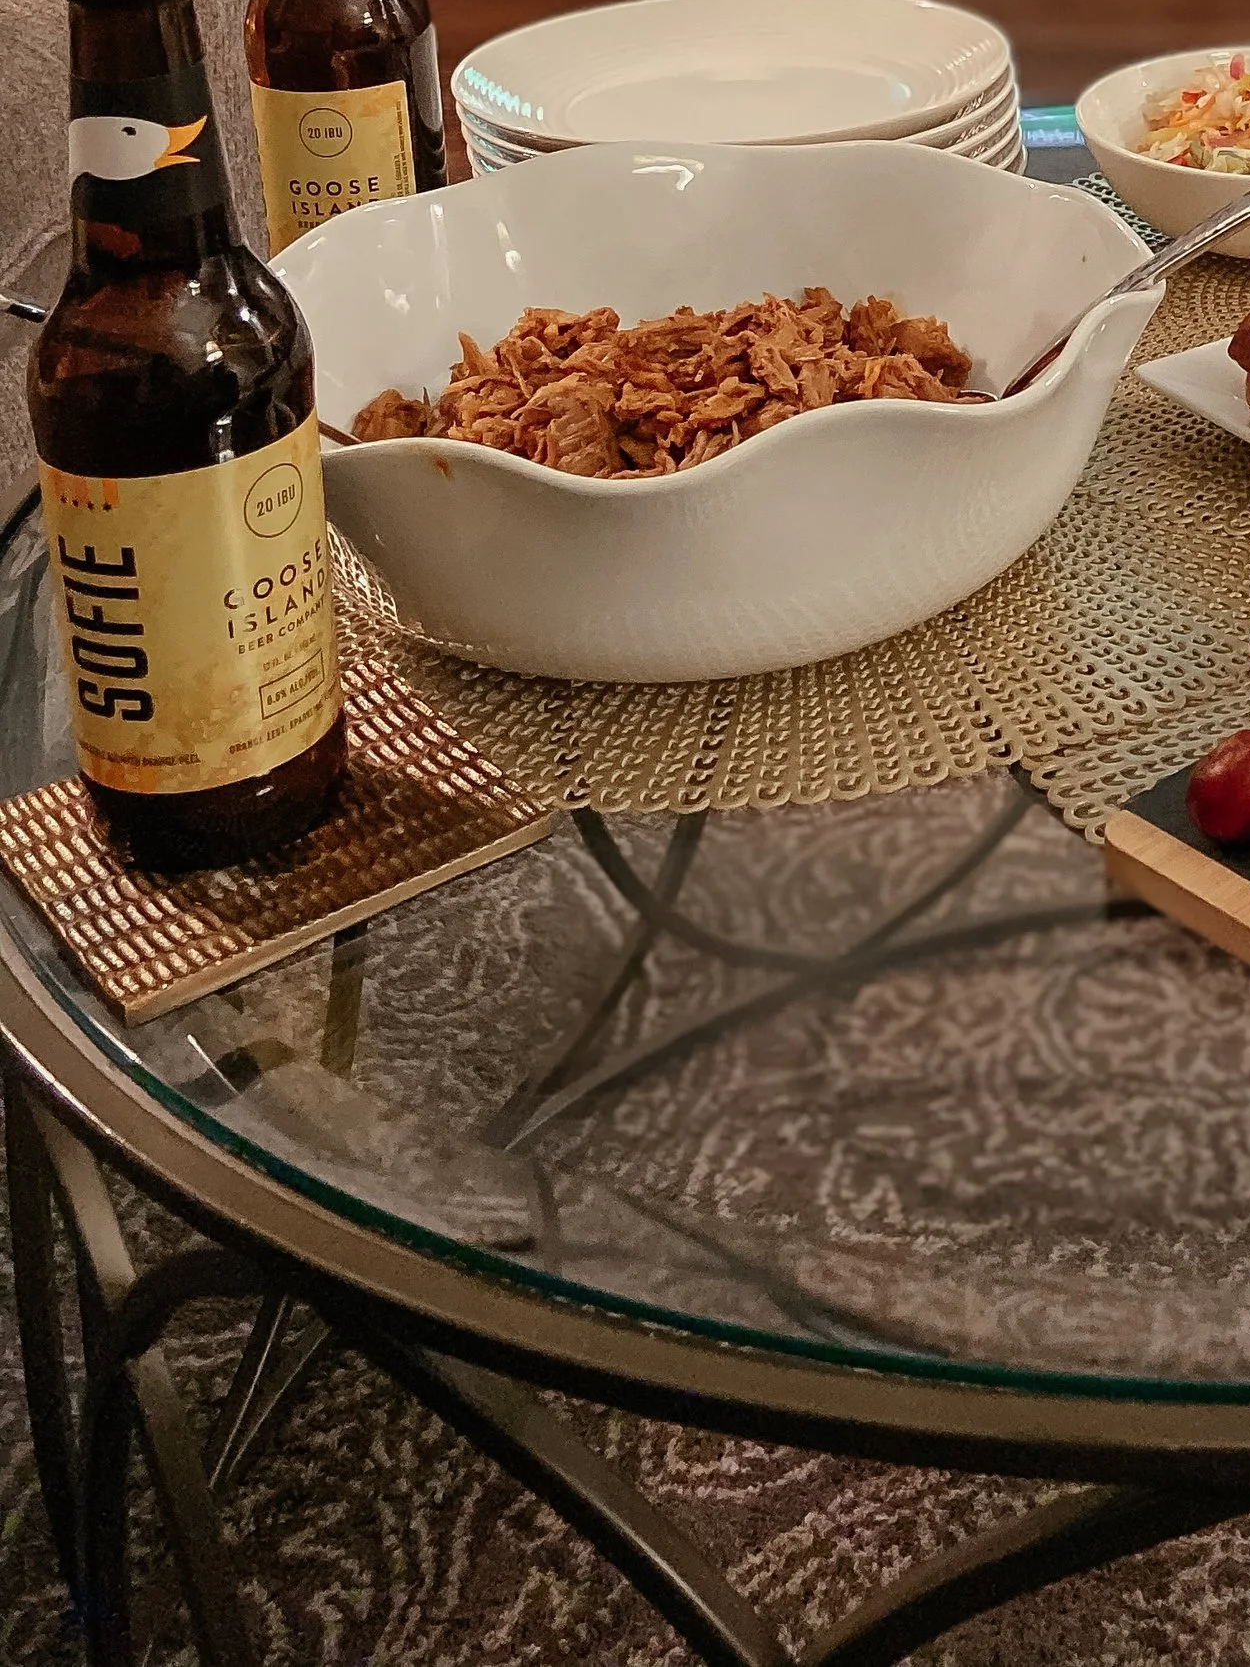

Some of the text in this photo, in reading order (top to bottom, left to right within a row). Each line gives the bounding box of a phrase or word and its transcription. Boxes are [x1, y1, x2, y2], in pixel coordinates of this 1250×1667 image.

[307, 126, 342, 139] 20 IBU
[289, 176, 380, 196] GOOSE
[256, 484, 296, 518] 20 IBU
[223, 538, 322, 610] GOOSE
[228, 567, 325, 639] ISLAND
[58, 535, 156, 722] SOFIE
[238, 633, 274, 655] BEER
[278, 594, 325, 637] COMPANY
